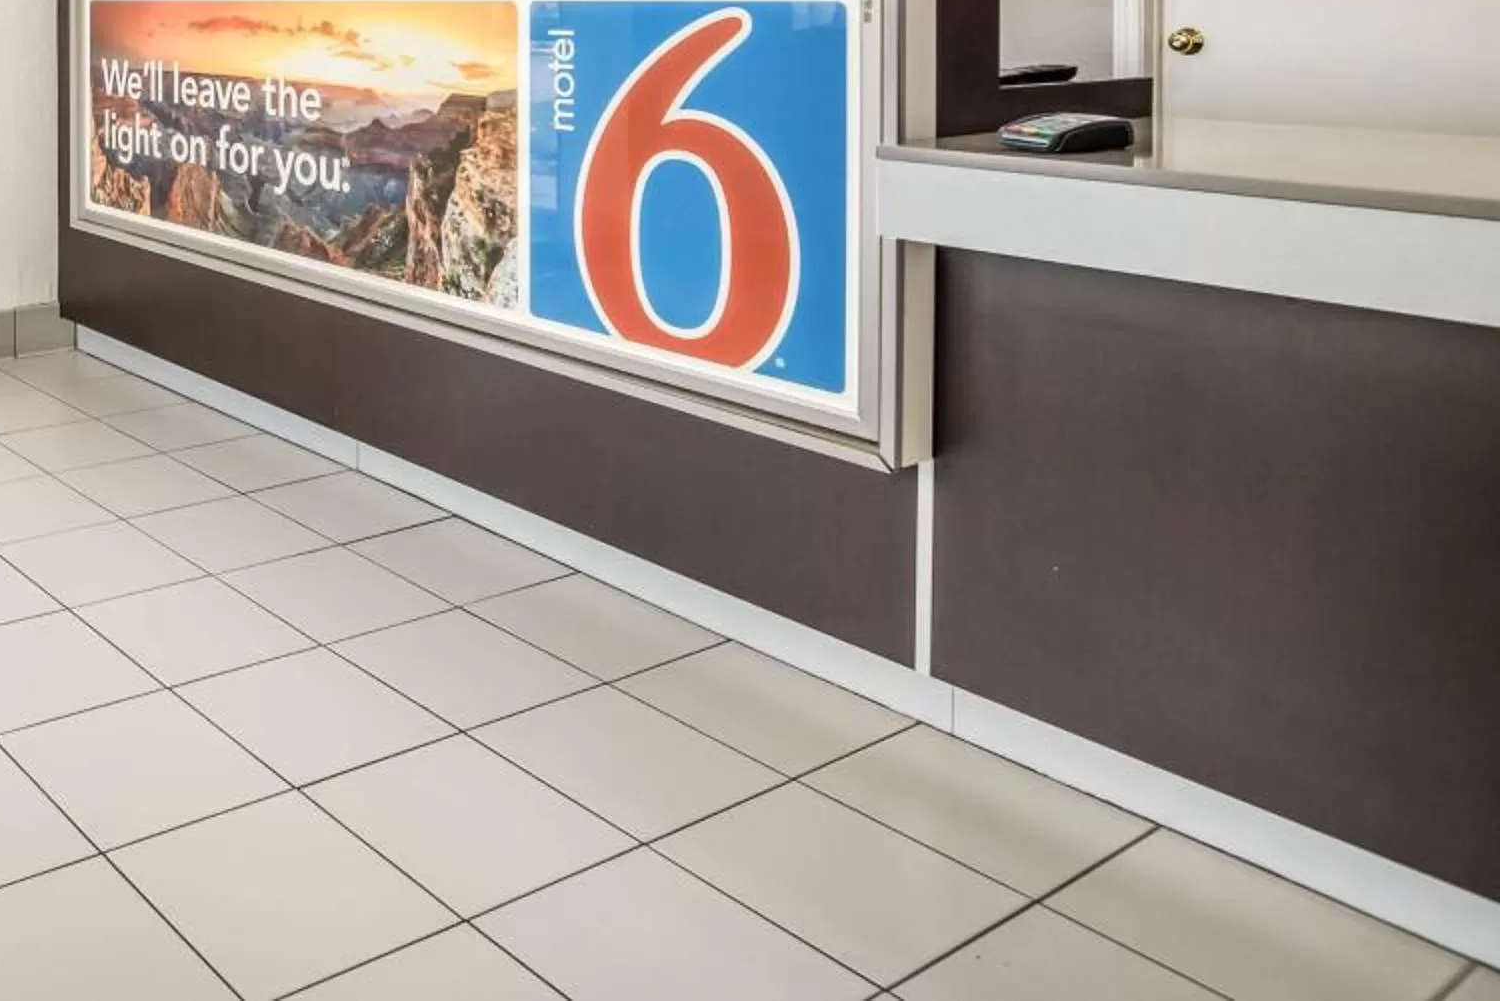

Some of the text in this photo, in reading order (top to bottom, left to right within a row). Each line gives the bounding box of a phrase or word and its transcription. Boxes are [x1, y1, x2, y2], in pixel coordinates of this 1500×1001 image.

[102, 58, 322, 122] We'll leave the
[104, 109, 162, 165] light
[170, 131, 207, 167] on
[216, 124, 264, 177] for
[547, 7, 801, 371] motel 6
